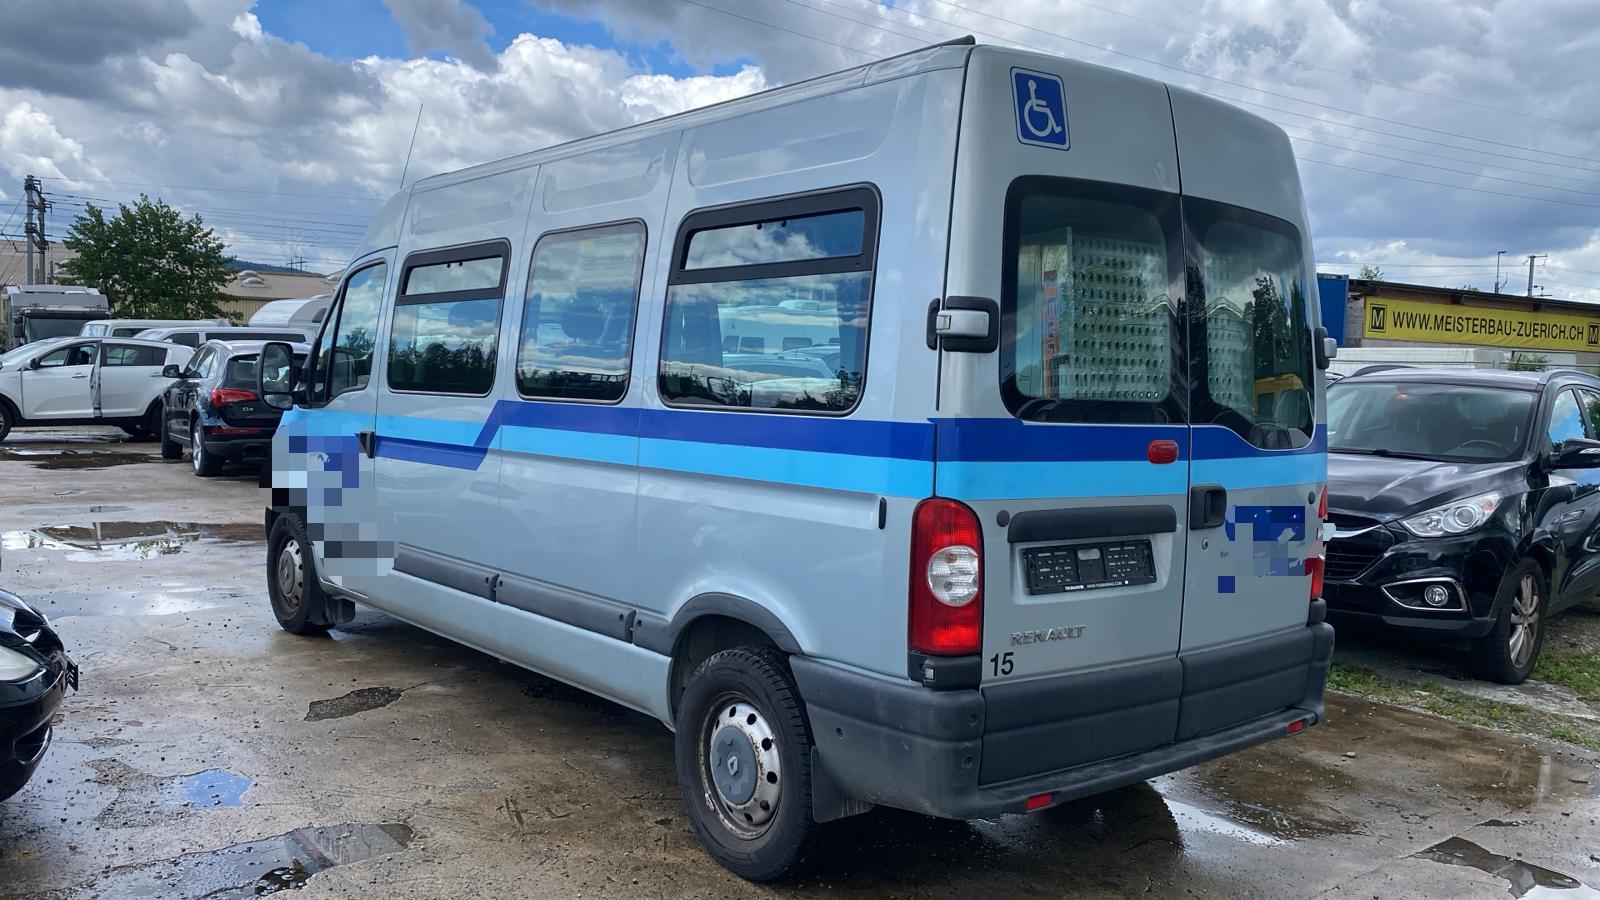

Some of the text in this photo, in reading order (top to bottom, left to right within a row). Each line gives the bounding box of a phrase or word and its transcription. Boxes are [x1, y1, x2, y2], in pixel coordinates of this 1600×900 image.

[1393, 311, 1584, 341] WWW.MEISTERBAU-ZUERICH.CH
[1010, 624, 1086, 646] RENAULT
[990, 652, 1014, 677] 15
